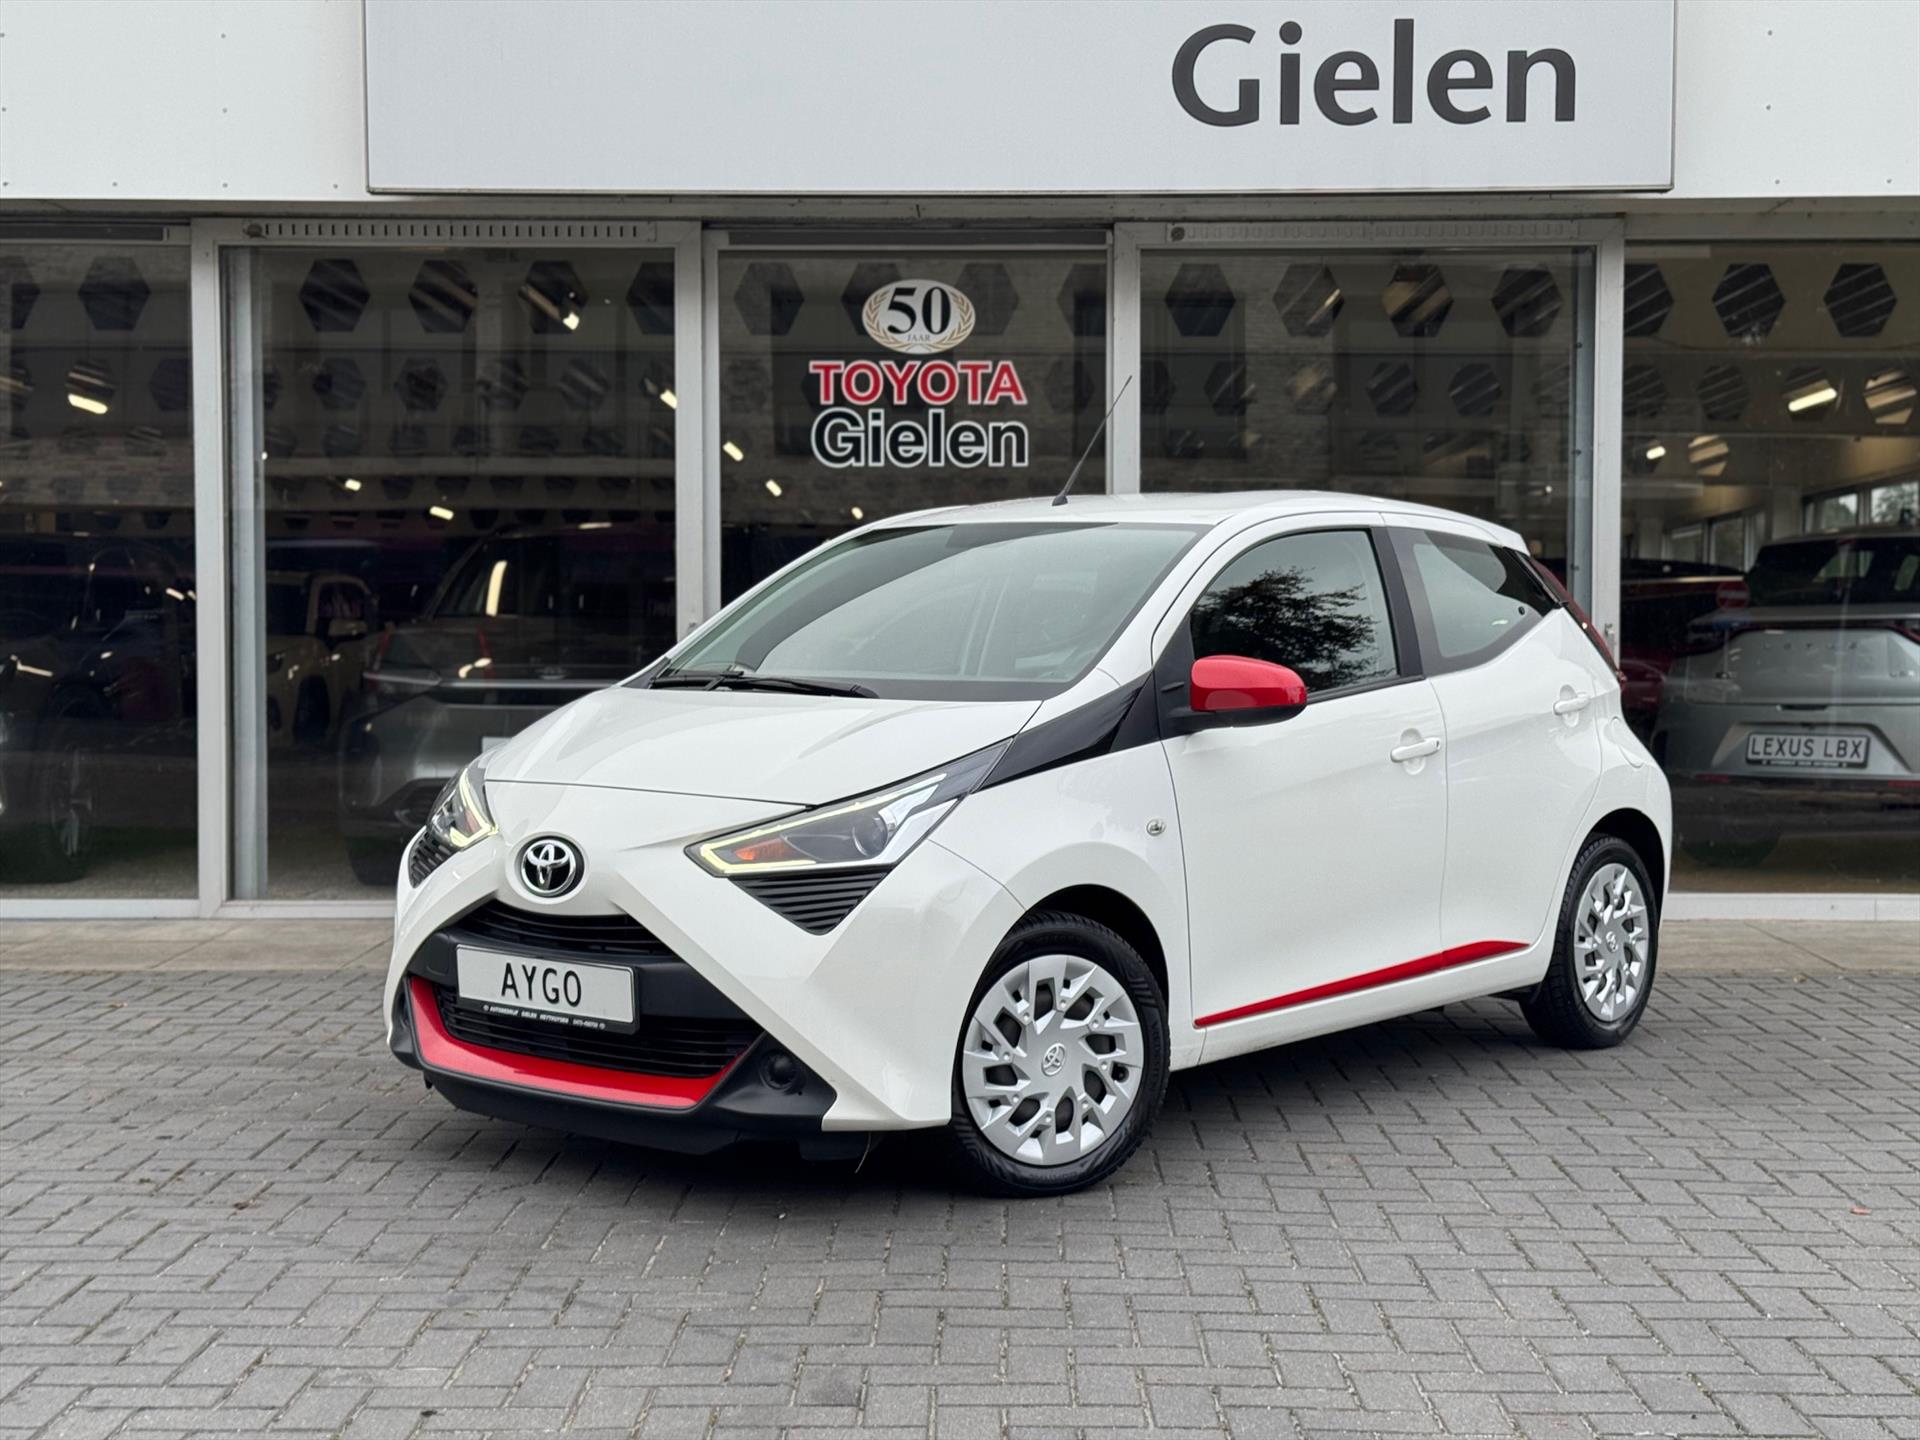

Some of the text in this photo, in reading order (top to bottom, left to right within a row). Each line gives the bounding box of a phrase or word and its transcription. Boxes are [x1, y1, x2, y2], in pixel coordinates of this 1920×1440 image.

[1172, 18, 1576, 127] Gielen
[887, 286, 951, 335] 50
[907, 333, 931, 342] JAAR
[809, 360, 1028, 405] TOYOTA
[810, 407, 1029, 468] Gielen
[1751, 737, 1862, 759] LEXUS LBX
[501, 962, 582, 1007] AYGO
